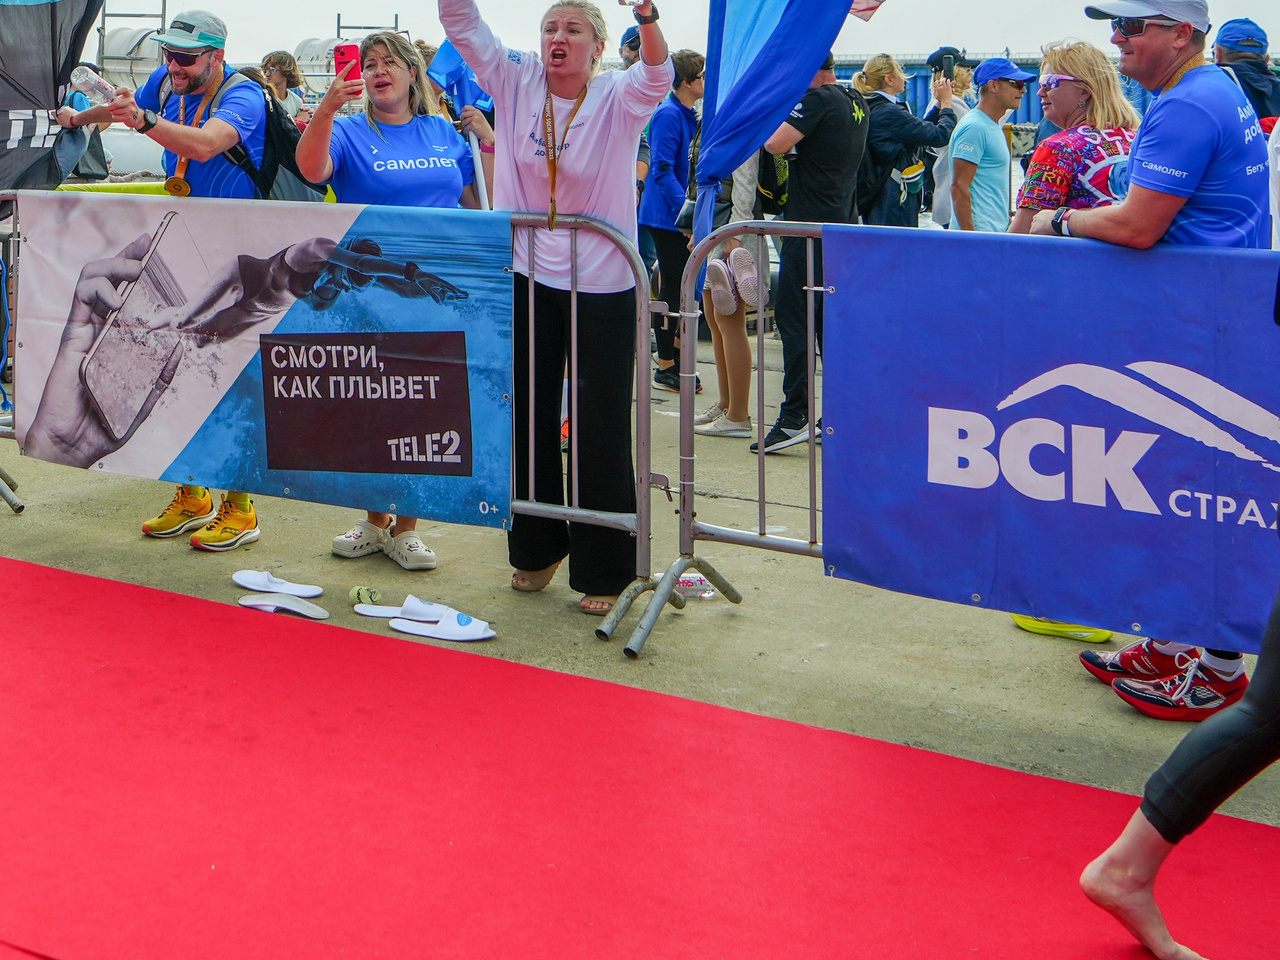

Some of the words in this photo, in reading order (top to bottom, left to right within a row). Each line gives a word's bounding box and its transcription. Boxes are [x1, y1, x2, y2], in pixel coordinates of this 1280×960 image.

[373, 157, 458, 172] самолет
[1141, 160, 1188, 179] самолет
[270, 345, 385, 372] СМОТРИ,
[272, 375, 322, 398] КАК
[328, 375, 440, 399] ПЛЫВЕТ
[387, 430, 462, 463] TELE2
[927, 406, 1163, 516] ВСК
[478, 500, 499, 514] 0+
